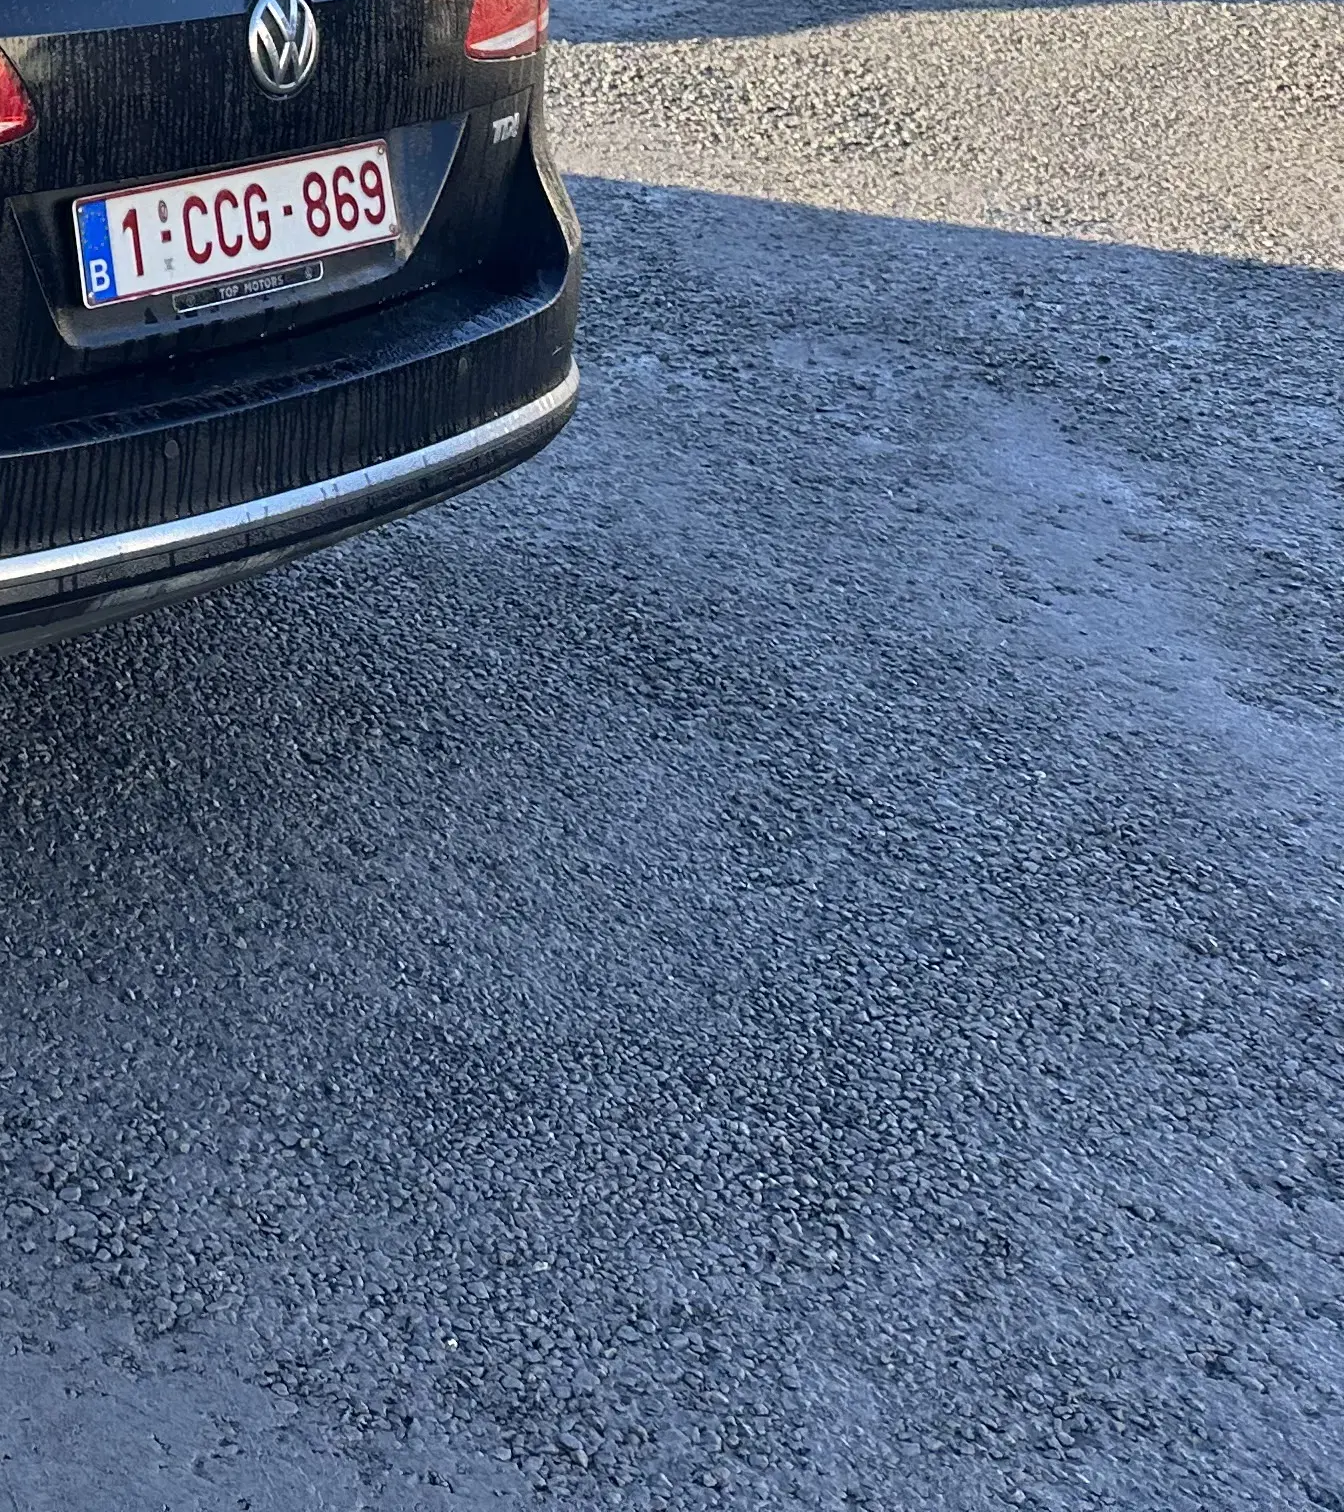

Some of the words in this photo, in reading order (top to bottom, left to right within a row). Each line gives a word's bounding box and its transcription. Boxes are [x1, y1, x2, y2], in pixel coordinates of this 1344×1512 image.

[492, 112, 520, 144] TDI
[89, 258, 112, 293] B
[218, 286, 240, 300] TOP
[243, 274, 285, 294] MOTORS
